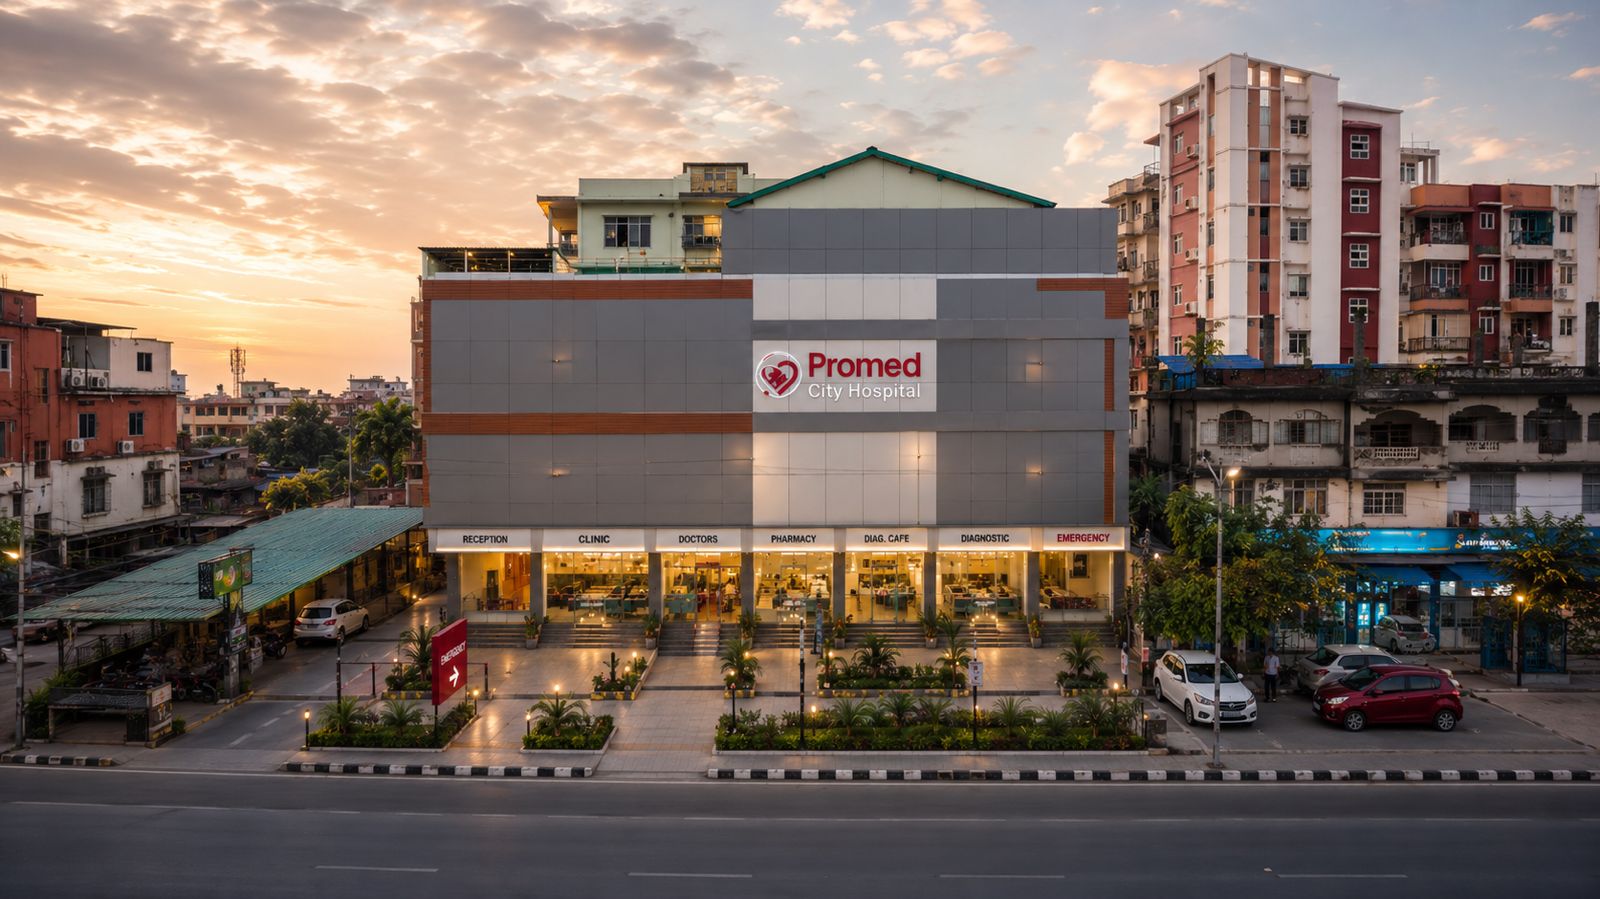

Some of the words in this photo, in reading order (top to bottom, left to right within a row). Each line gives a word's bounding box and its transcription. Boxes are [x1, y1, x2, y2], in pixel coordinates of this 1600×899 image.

[808, 352, 921, 378] Promed
[808, 384, 843, 401] City
[849, 384, 921, 402] Hospital
[462, 535, 508, 544] RECEPTION
[578, 535, 610, 544] CLINIC
[678, 535, 718, 544] DOCTORS
[770, 534, 817, 543] PHARMACY
[864, 534, 887, 543] DIAG.
[888, 534, 910, 543] CAFE
[961, 534, 1010, 543] DIAGNOSTIC
[1057, 533, 1110, 543] EMERGENCY
